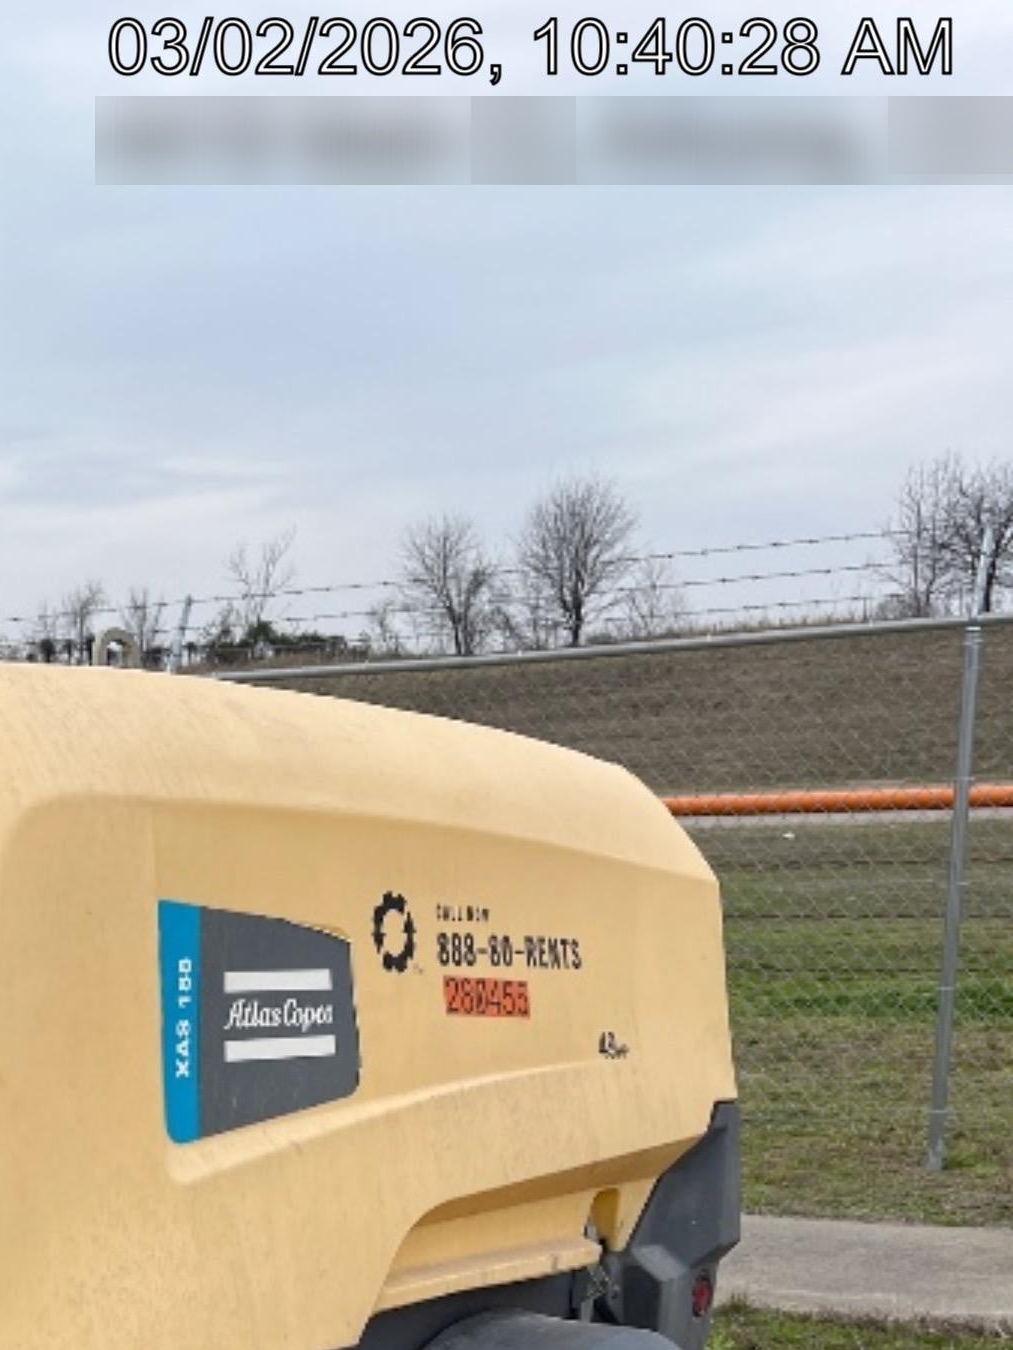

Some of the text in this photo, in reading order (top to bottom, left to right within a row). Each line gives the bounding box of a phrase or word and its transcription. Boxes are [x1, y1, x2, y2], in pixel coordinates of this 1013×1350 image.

[437, 932, 582, 970] 888-80-RENTS
[223, 997, 334, 1032] Atlas Copco
[175, 1019, 192, 1078] XAS
